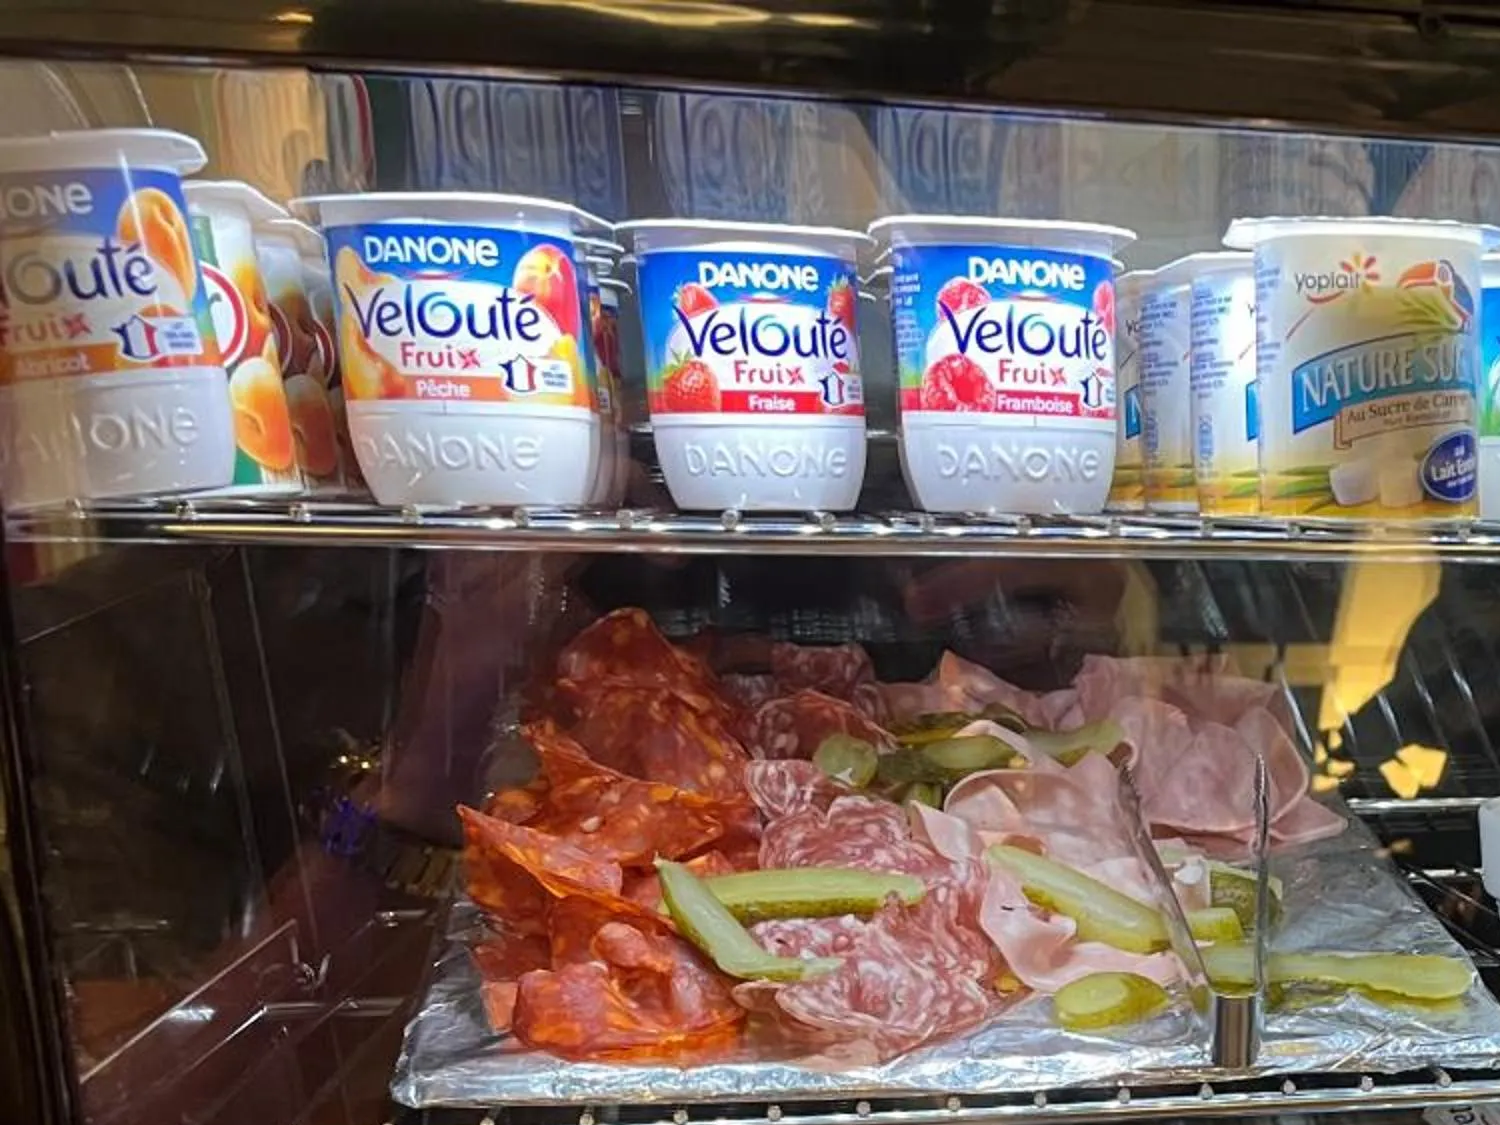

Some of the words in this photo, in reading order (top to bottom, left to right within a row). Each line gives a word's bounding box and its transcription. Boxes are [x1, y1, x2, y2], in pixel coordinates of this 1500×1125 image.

[399, 342, 481, 369] Fruix
[734, 360, 805, 385] Fruix
[998, 358, 1067, 386] Fruix
[1302, 350, 1415, 412] NATURE
[415, 379, 471, 398] Pêche
[748, 395, 796, 411] Fraise
[1000, 394, 1073, 415] Framboise
